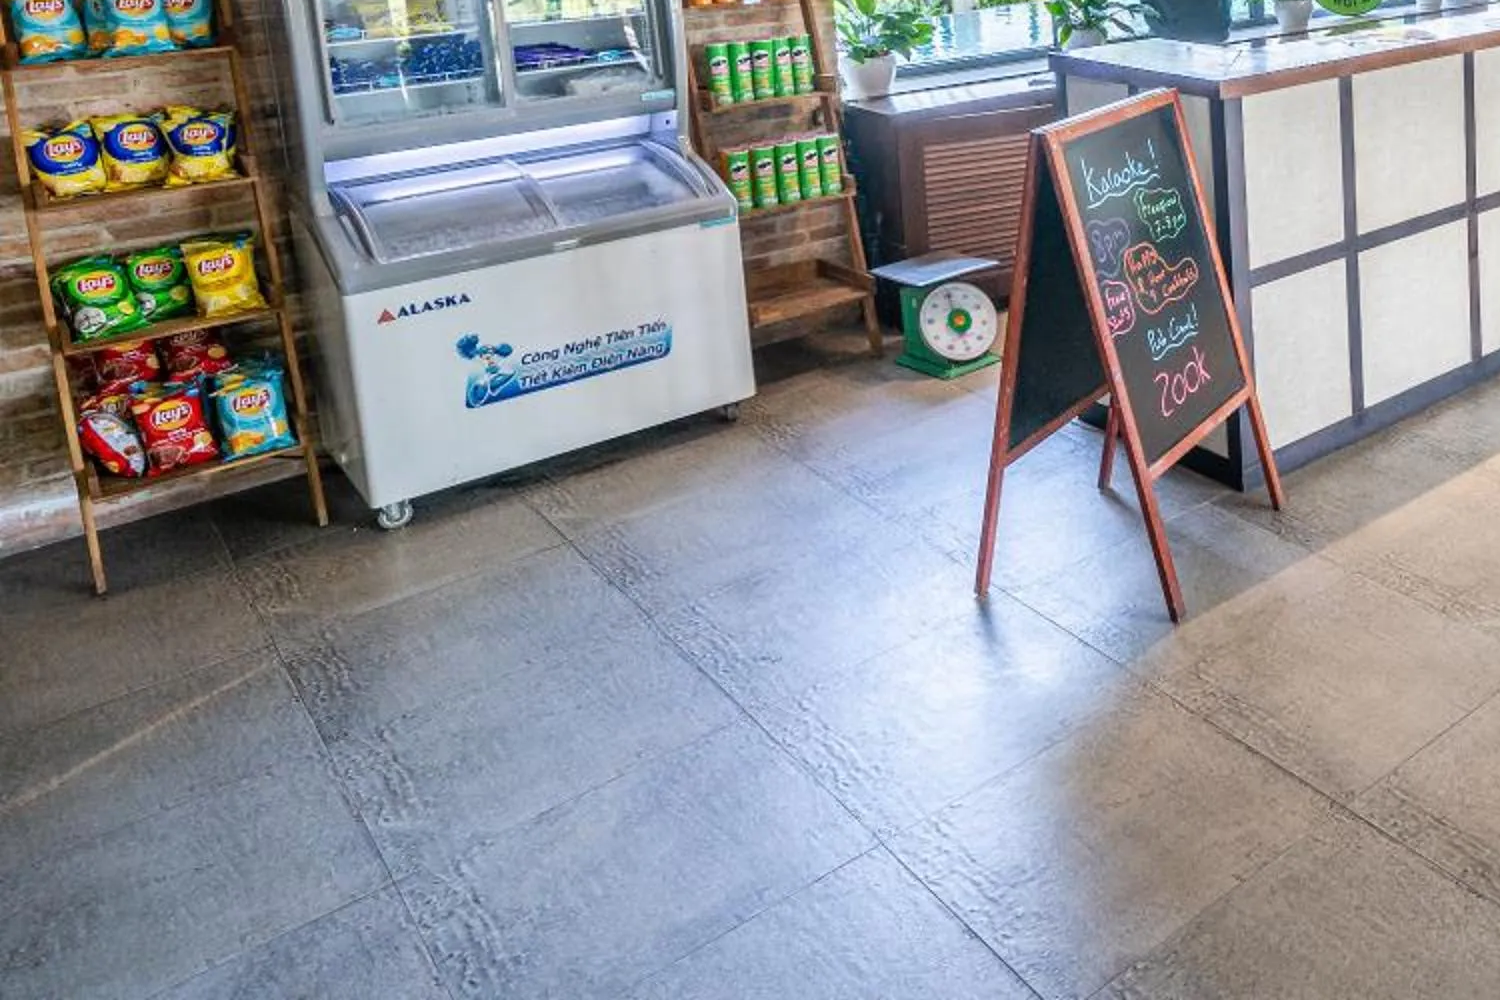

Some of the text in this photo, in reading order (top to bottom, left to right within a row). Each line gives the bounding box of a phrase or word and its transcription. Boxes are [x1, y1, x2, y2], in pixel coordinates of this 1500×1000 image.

[29, 0, 63, 13] Lay's
[123, 131, 154, 143] Lay's
[183, 127, 215, 139] Lay's
[50, 142, 81, 156] Lay's
[137, 261, 173, 275] Lay's
[200, 253, 235, 273] Lay's
[78, 276, 115, 292] Lay's
[397, 293, 471, 318] ALASKA
[155, 406, 191, 426] Lay's
